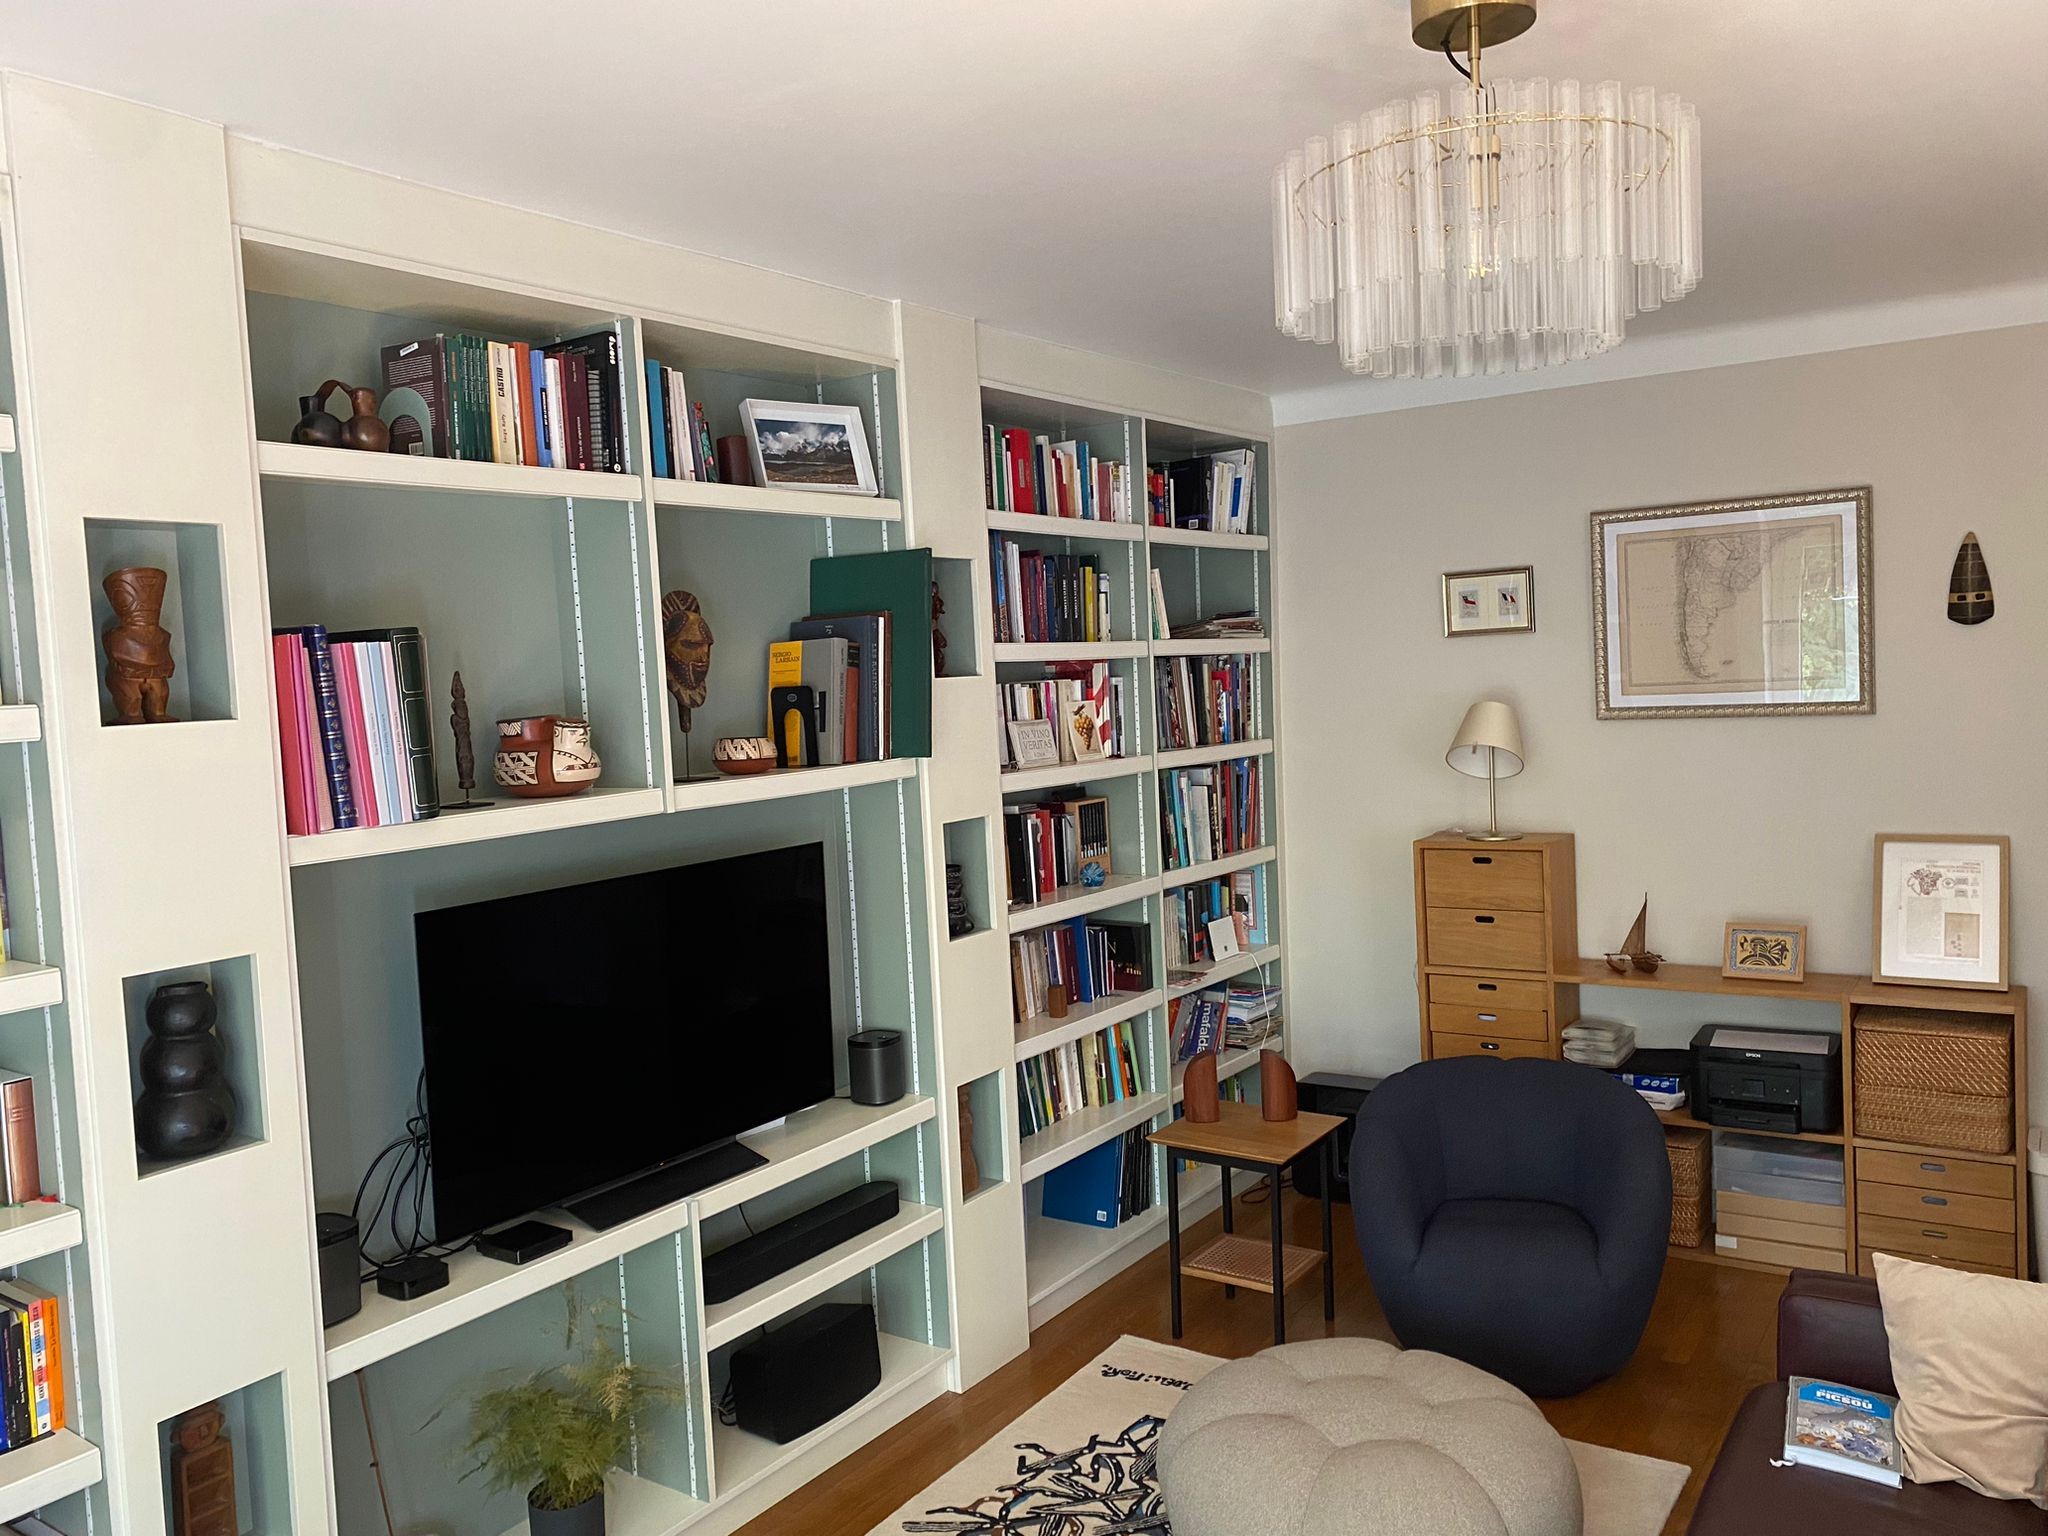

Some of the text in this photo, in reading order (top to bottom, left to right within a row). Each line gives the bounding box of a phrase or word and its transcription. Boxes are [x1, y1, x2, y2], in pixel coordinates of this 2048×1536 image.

[497, 366, 505, 398] CASTRO
[775, 655, 800, 664] LARRAIN
[1021, 728, 1050, 740] IN VINO
[1022, 739, 1053, 750] VERITAS
[1195, 1001, 1213, 1053] mafalda
[36, 1365, 45, 1383] MILLER
[37, 1383, 46, 1400] HENRY
[1815, 1390, 1873, 1410] PICSOU
